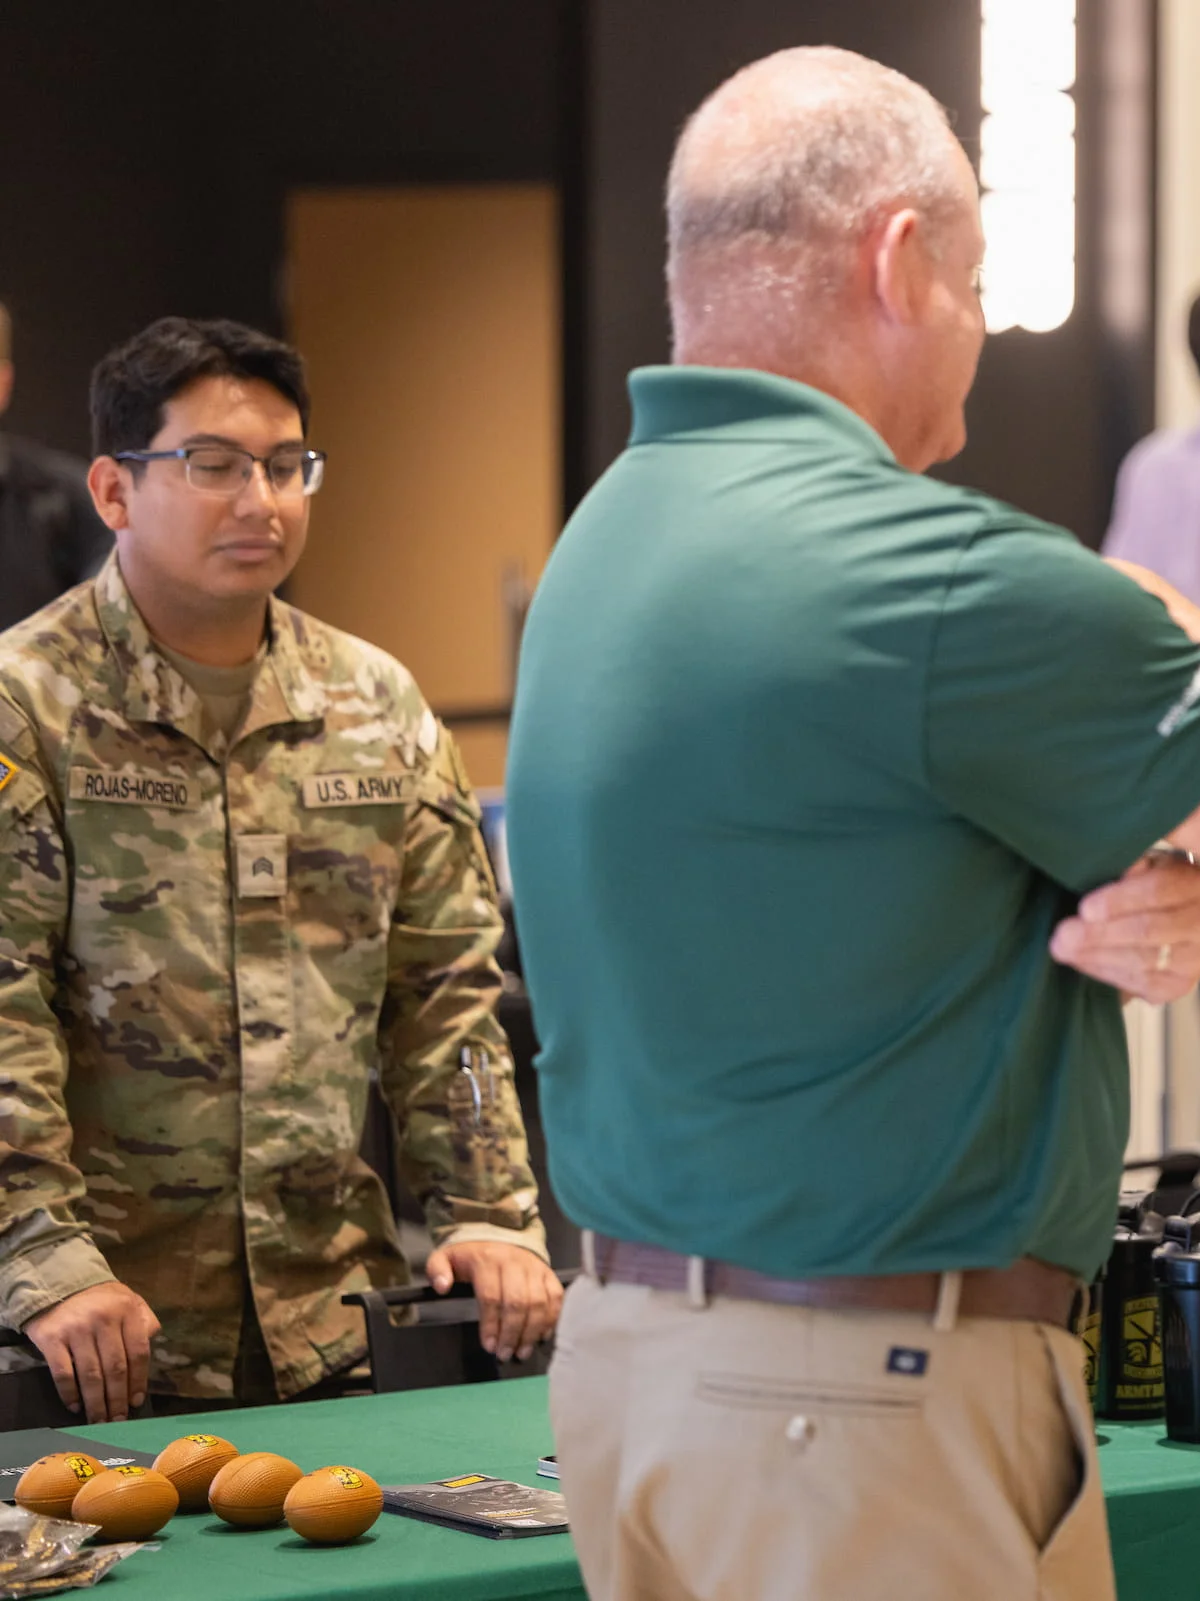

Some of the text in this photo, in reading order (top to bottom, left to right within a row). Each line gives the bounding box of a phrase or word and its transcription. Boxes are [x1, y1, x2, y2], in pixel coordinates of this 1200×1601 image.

[85, 774, 188, 806] ROJAS-MORENO
[316, 775, 403, 803] U.S. ARMY
